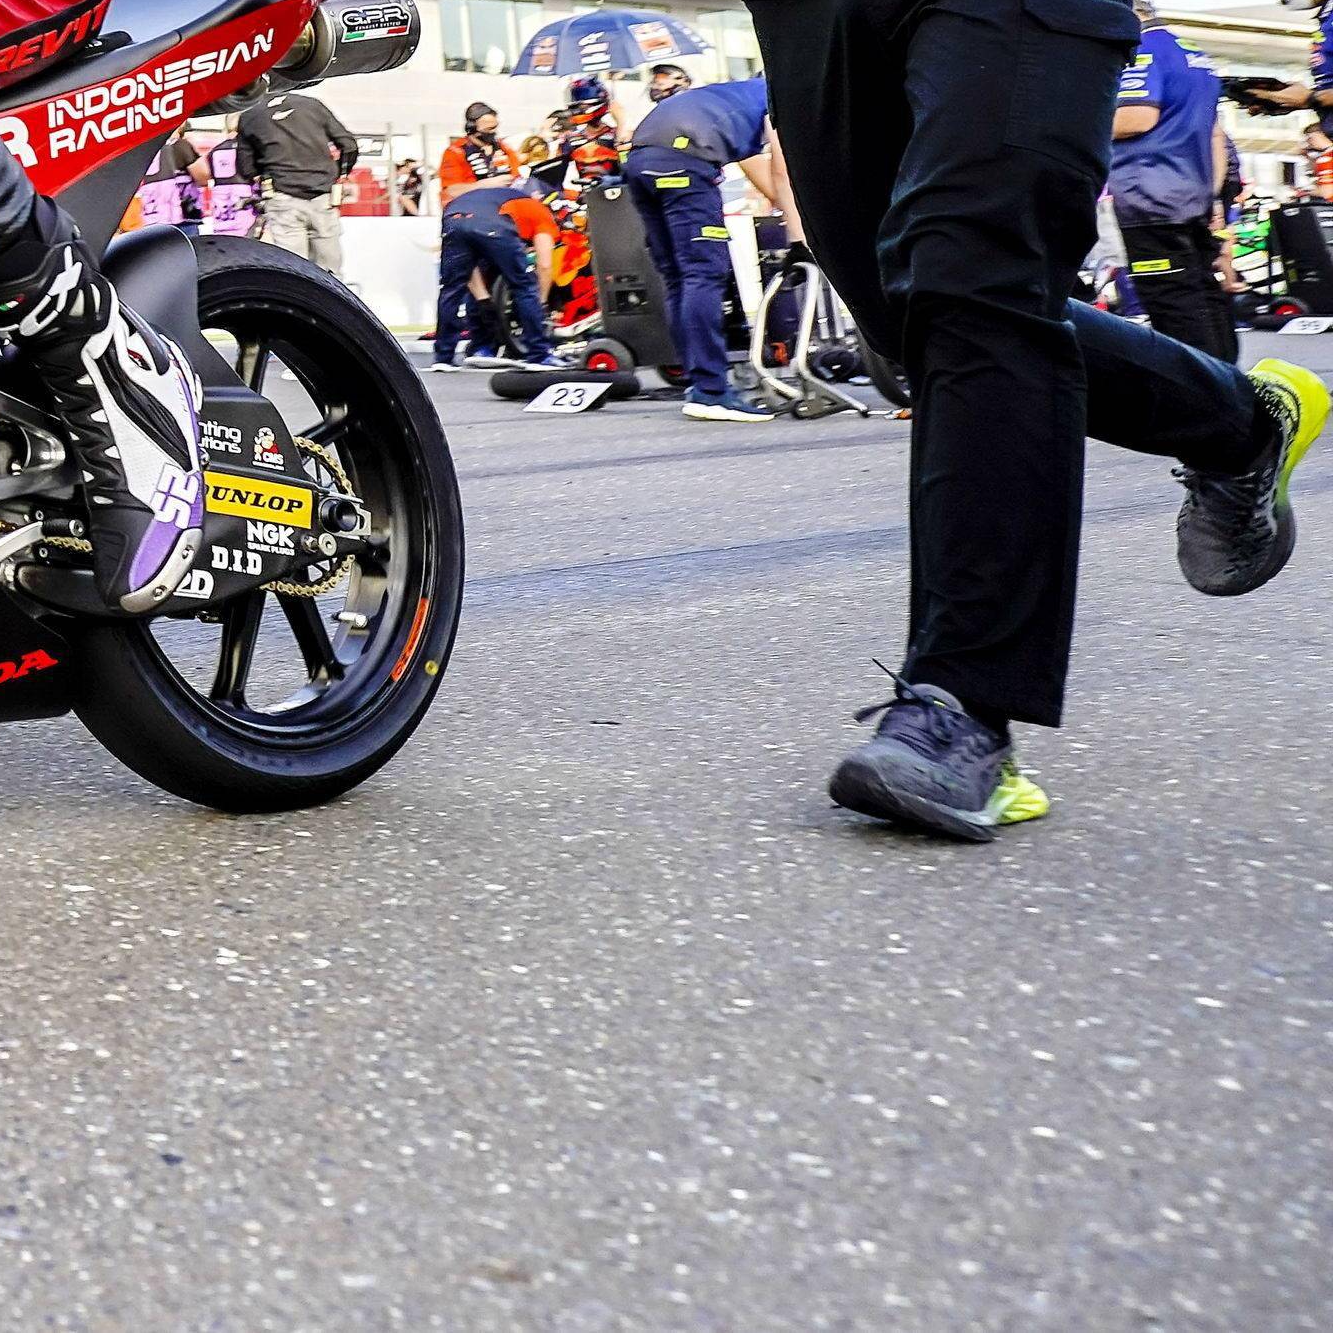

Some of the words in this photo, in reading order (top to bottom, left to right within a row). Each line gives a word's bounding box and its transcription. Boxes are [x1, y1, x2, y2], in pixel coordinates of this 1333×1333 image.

[47, 27, 275, 129] INDONESIAN
[49, 89, 185, 159] RACING
[552, 387, 586, 407] 23
[246, 520, 295, 548] NGK
[211, 545, 263, 576] D.I.D
